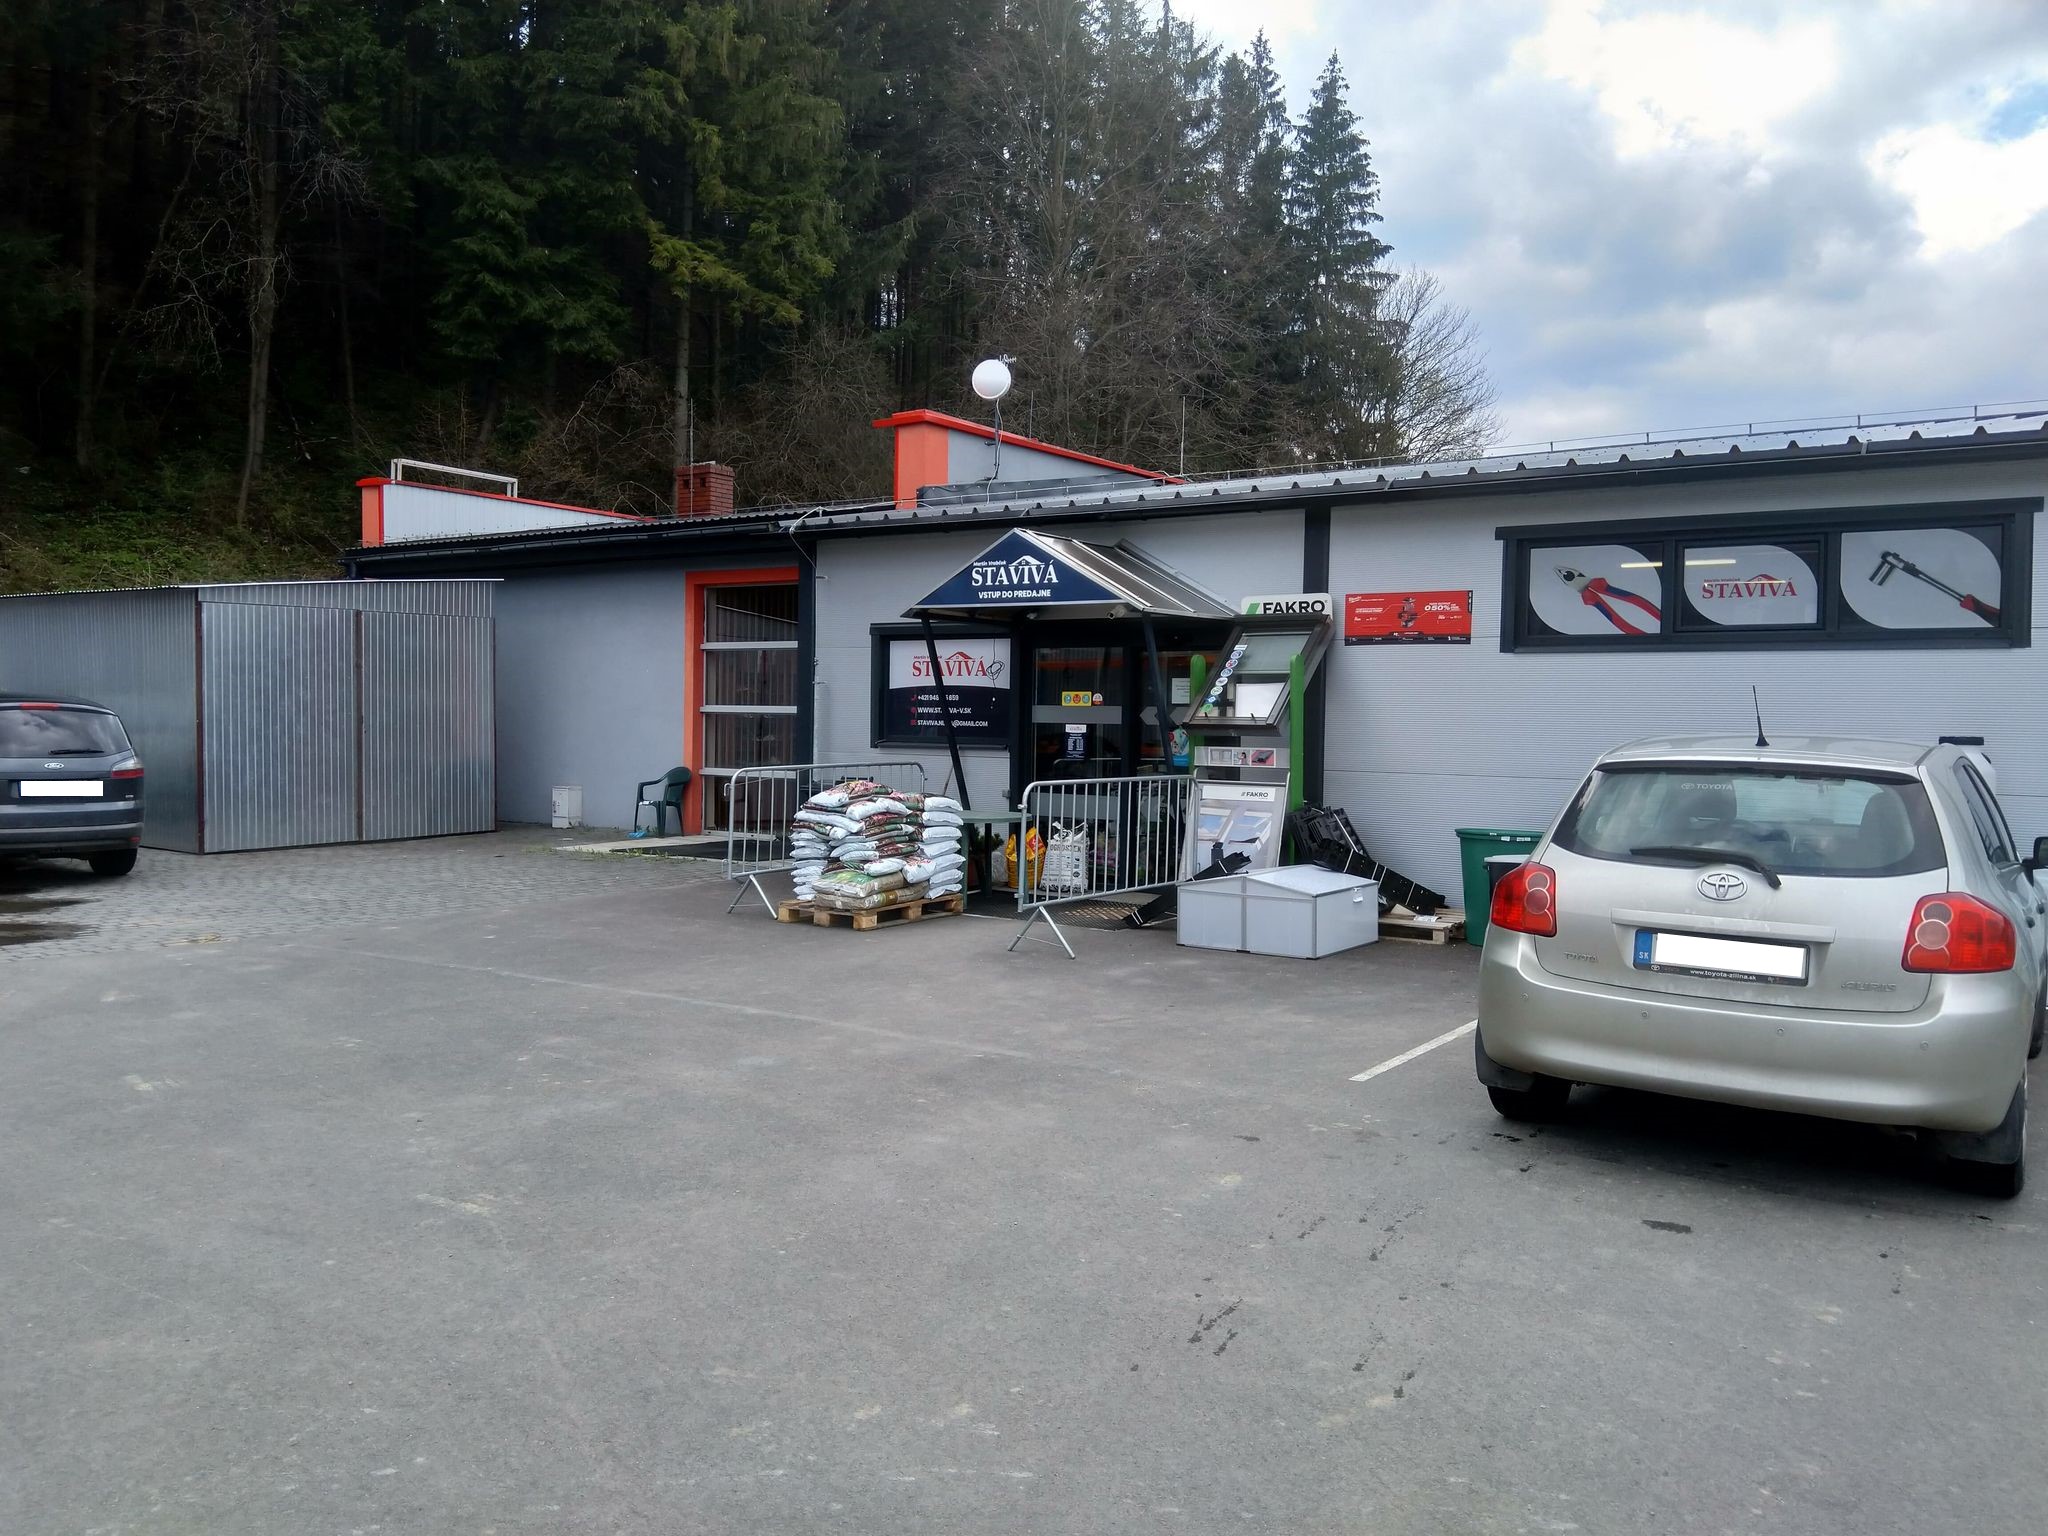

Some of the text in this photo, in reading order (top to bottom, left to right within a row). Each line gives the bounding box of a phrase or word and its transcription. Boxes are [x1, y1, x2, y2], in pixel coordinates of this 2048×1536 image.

[971, 560, 1059, 586] STAVIVÁ
[978, 589, 1052, 599] VSTUP DO PREDAJNE
[1702, 577, 1798, 599] STAVIVÁ
[1262, 600, 1325, 614] FAKRO
[1638, 951, 1649, 960] SK
